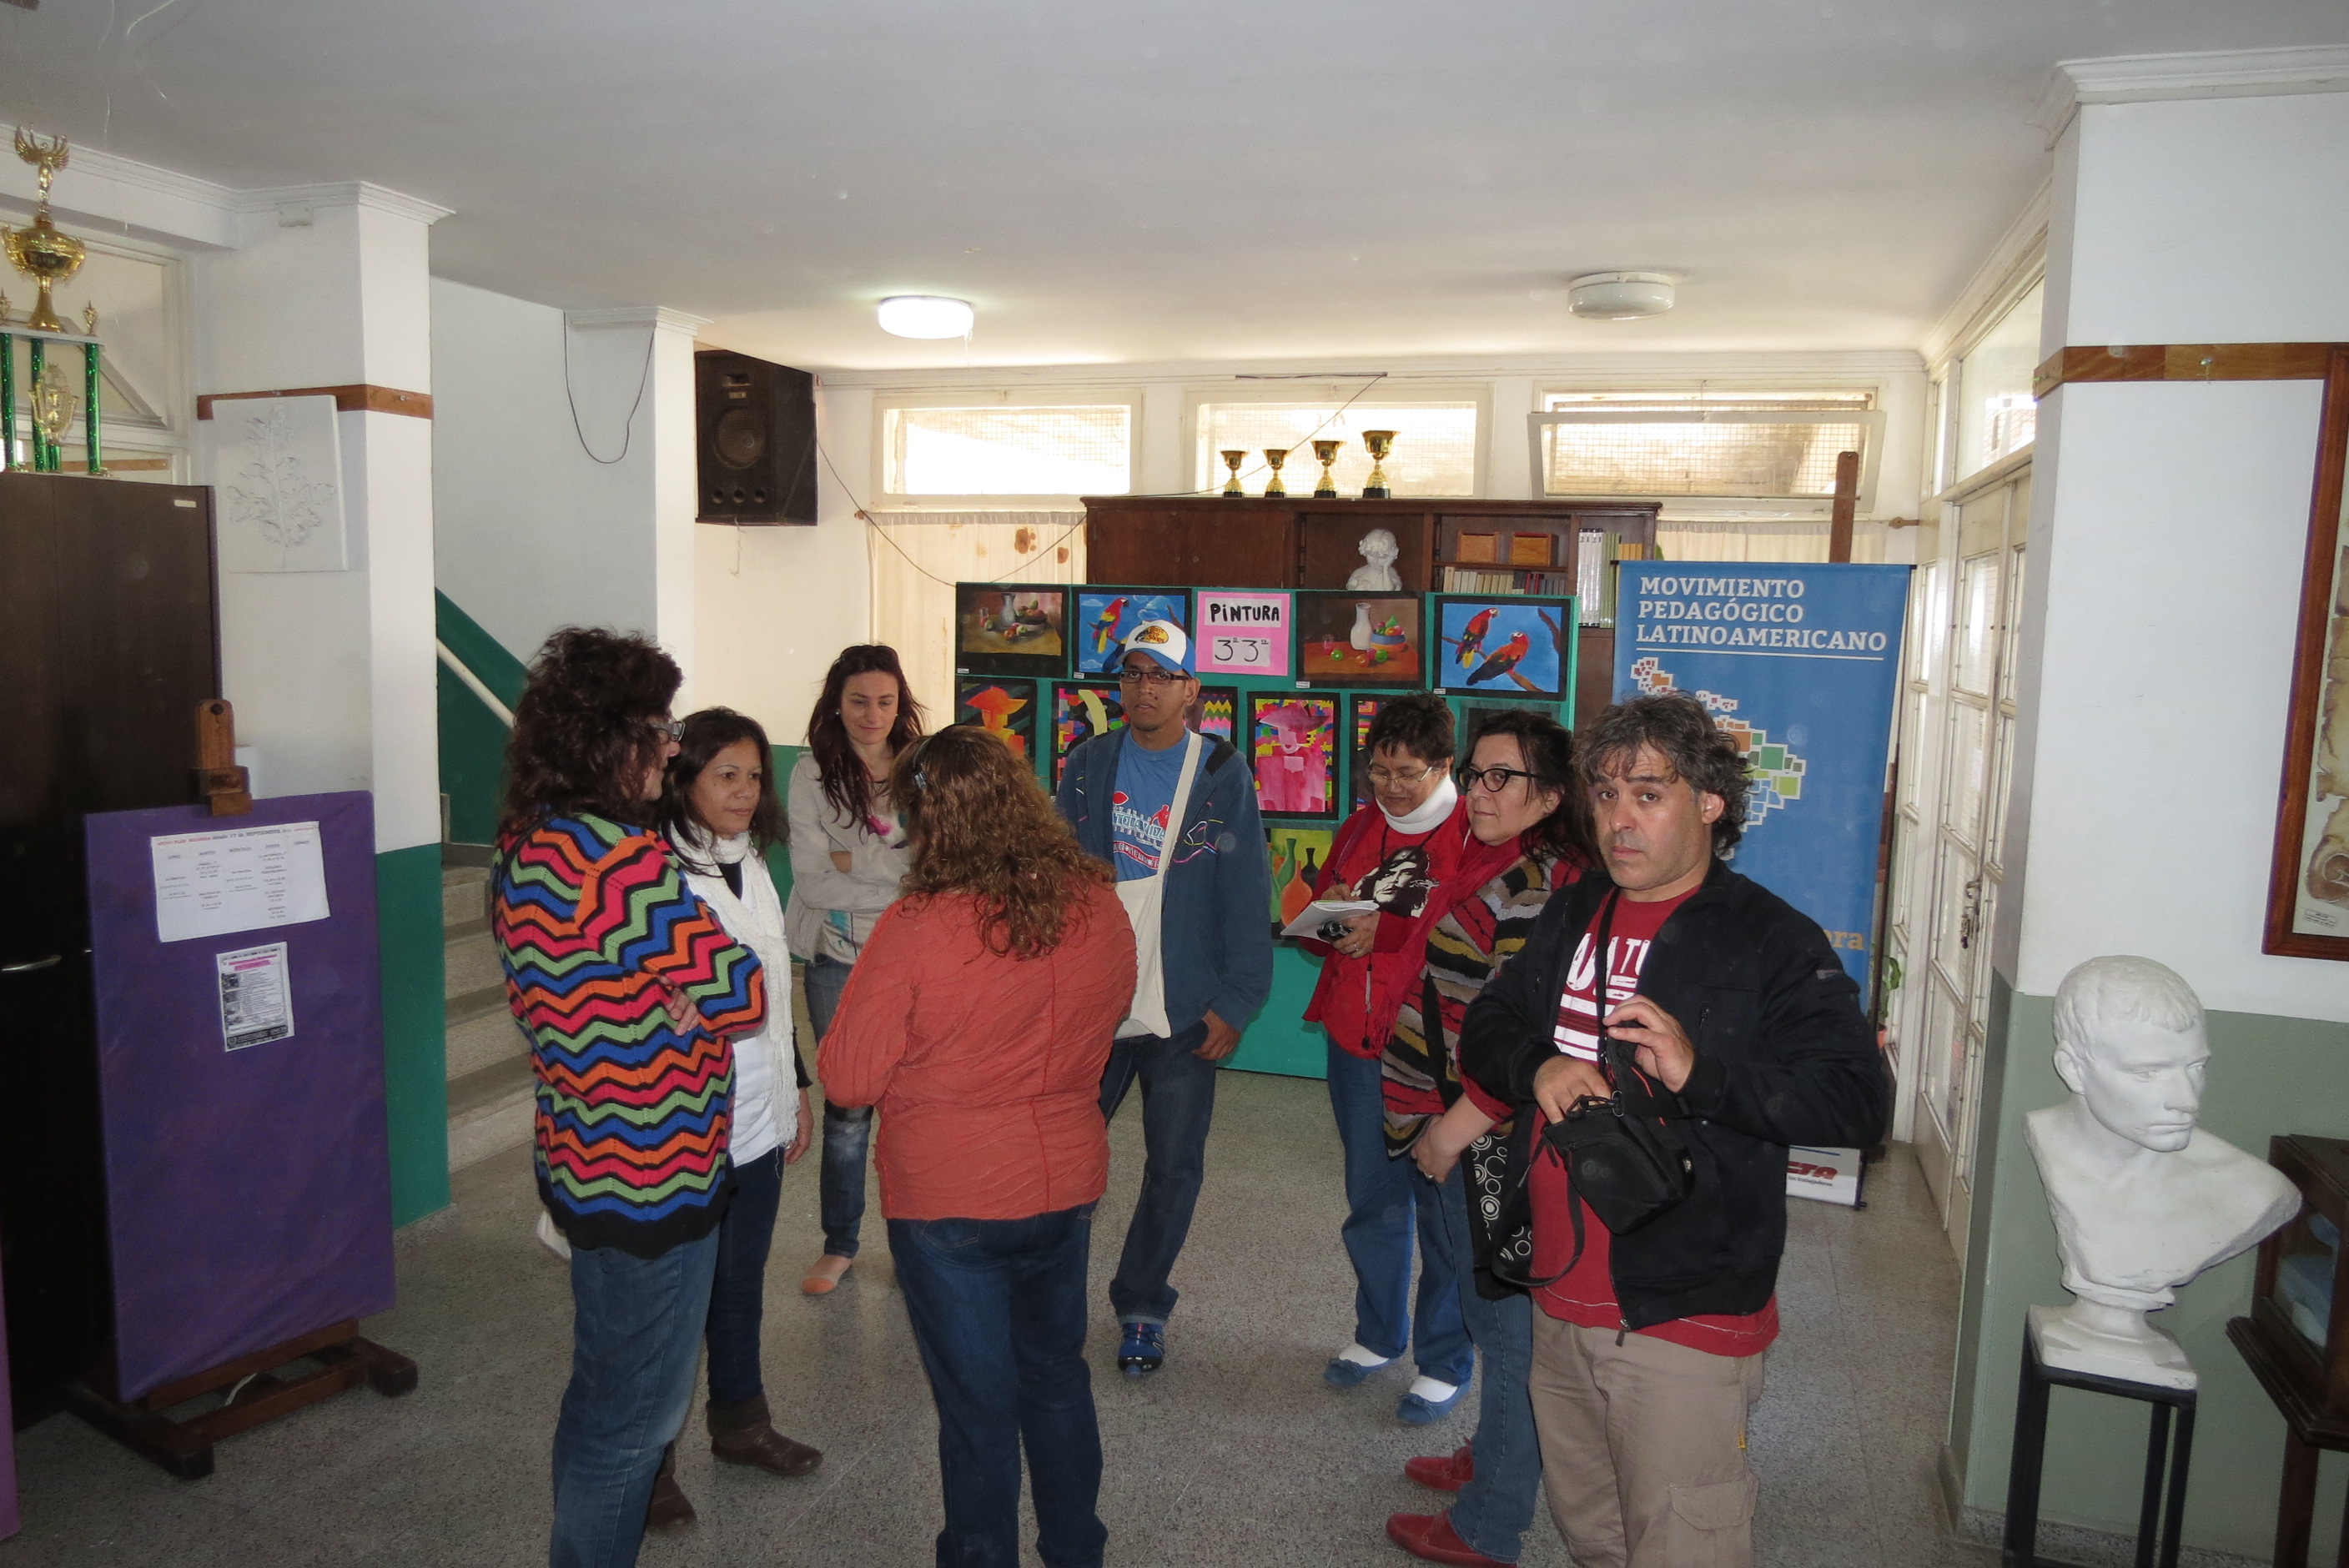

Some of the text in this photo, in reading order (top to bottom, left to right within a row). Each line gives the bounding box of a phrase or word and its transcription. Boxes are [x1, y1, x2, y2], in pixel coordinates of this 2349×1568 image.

[1639, 576, 1805, 599] MOVIMIENTO
[1637, 596, 1804, 624] PEDAGÓGICO
[1636, 624, 1888, 652] LATINOAMERICANO
